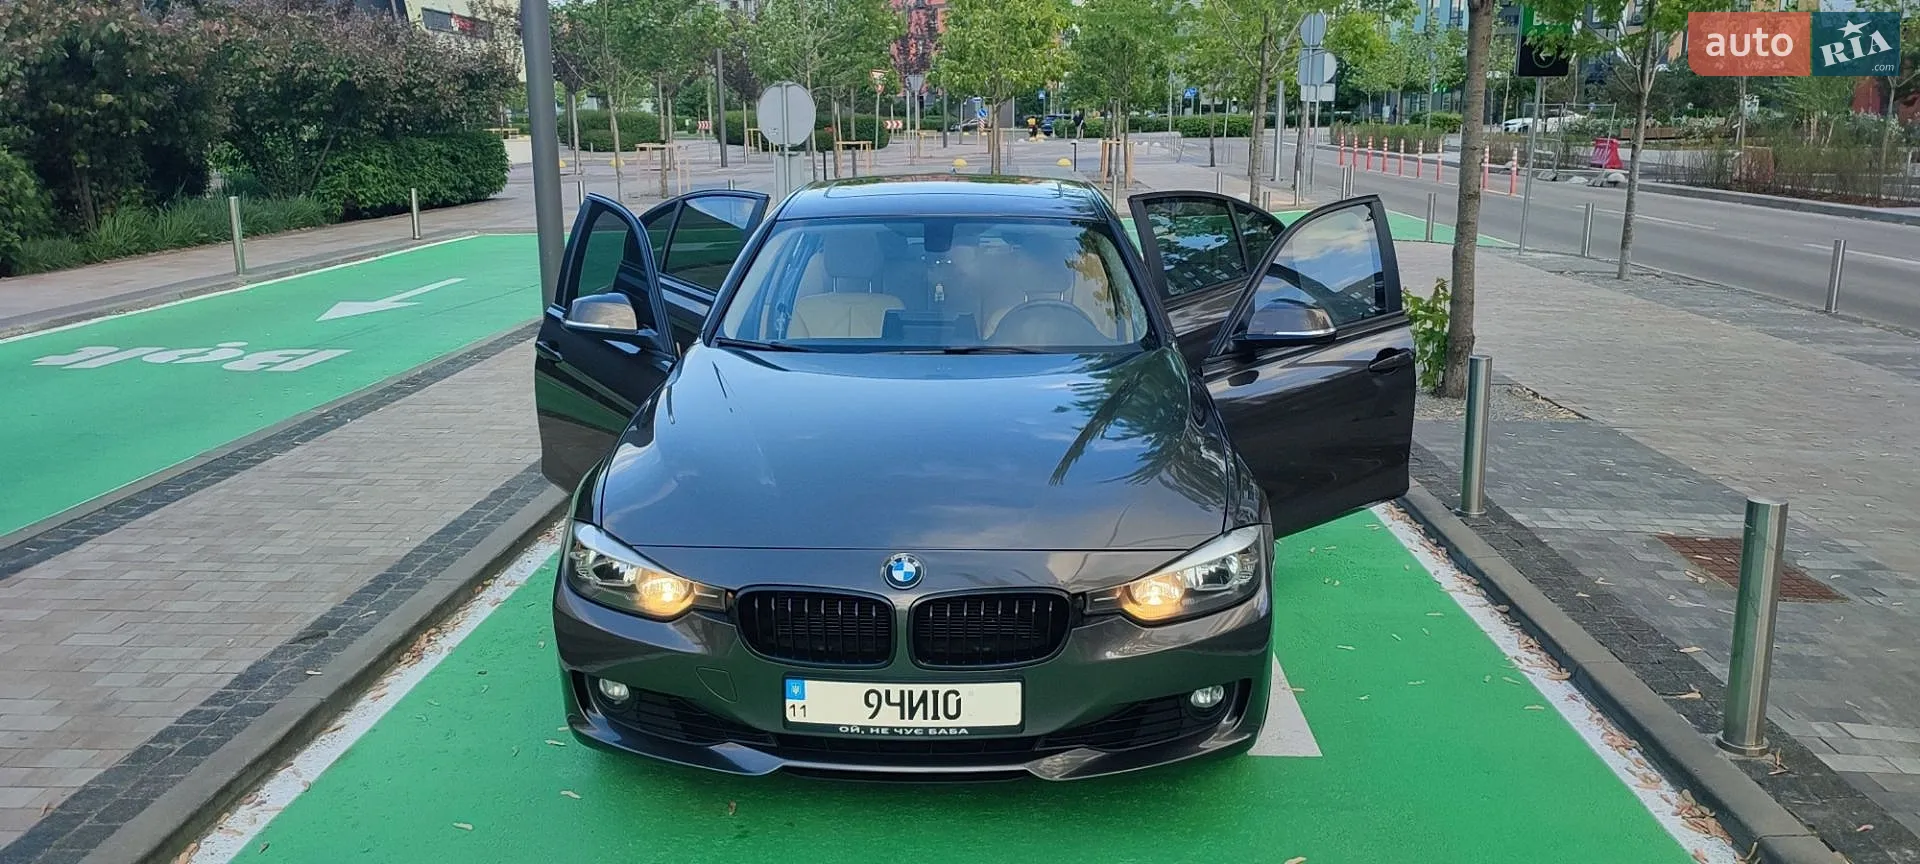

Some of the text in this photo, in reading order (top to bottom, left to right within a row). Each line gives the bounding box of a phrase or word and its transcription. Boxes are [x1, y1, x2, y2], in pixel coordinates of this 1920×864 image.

[31, 343, 352, 372] Bolt
[788, 704, 807, 717] 11
[838, 725, 865, 735] ОЙ,
[870, 727, 890, 735] НЕ
